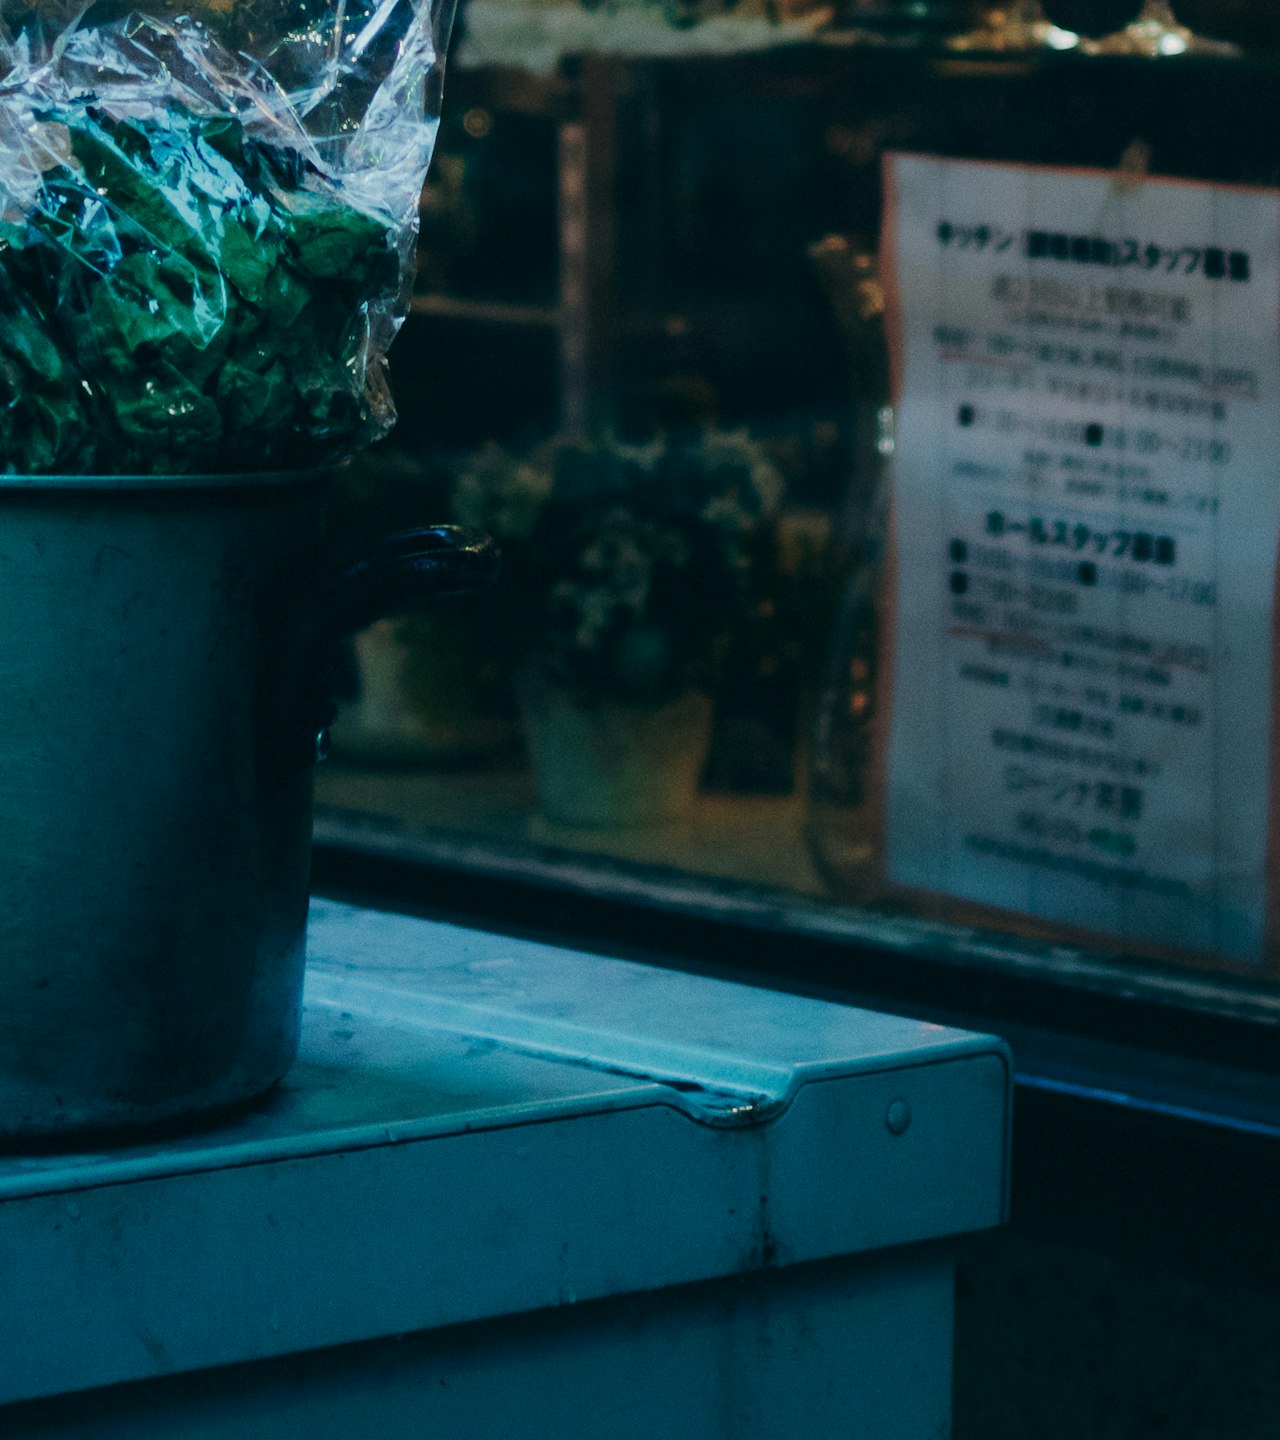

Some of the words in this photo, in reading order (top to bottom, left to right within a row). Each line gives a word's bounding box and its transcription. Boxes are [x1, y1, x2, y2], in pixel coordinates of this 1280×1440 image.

[986, 510, 1176, 565] ホールスタッフ
